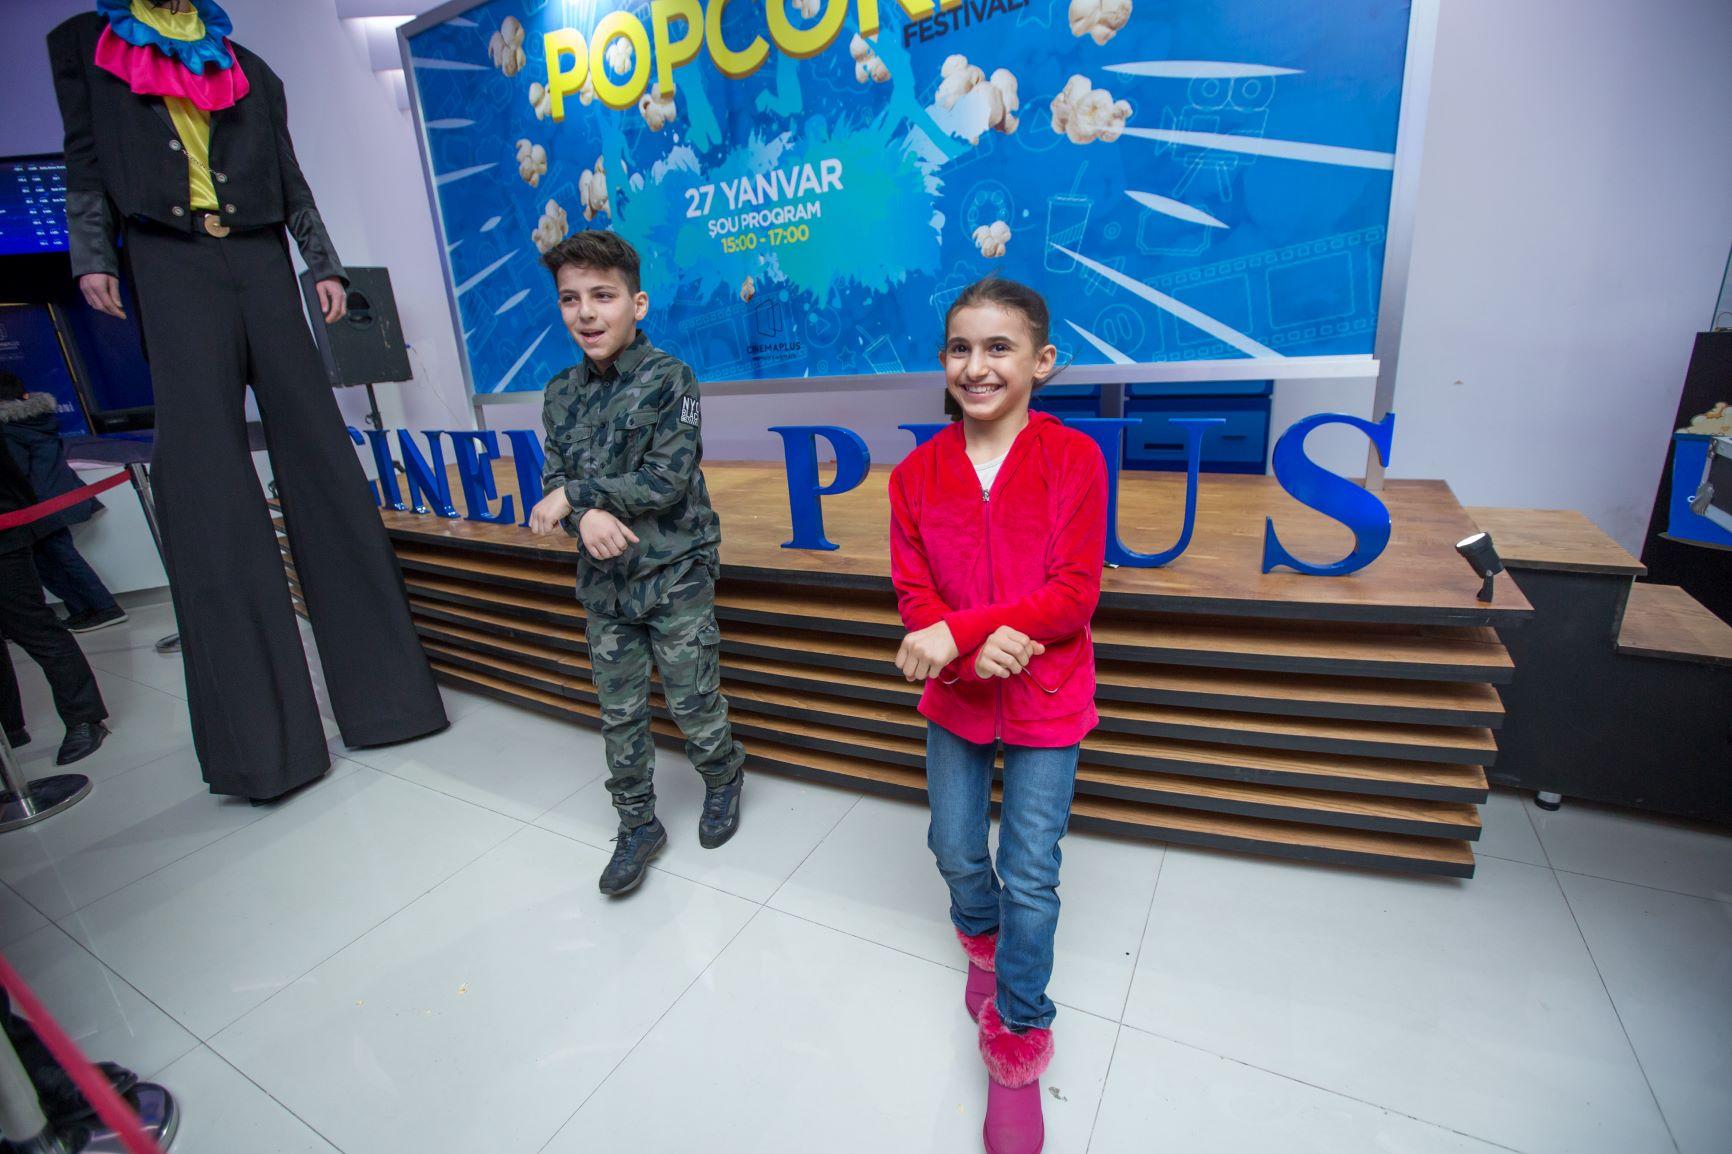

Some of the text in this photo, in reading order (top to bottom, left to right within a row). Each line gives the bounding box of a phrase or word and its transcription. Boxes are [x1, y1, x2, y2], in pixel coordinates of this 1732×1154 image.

[543, 0, 962, 122] POPCO
[684, 158, 844, 218] 27 YANVAR
[708, 200, 821, 238] ŞOU PROQRAM
[721, 233, 757, 253] 15:00
[768, 224, 809, 246] 17:00
[746, 341, 801, 354] CINEMAPLUS
[767, 411, 1396, 576] PUS
